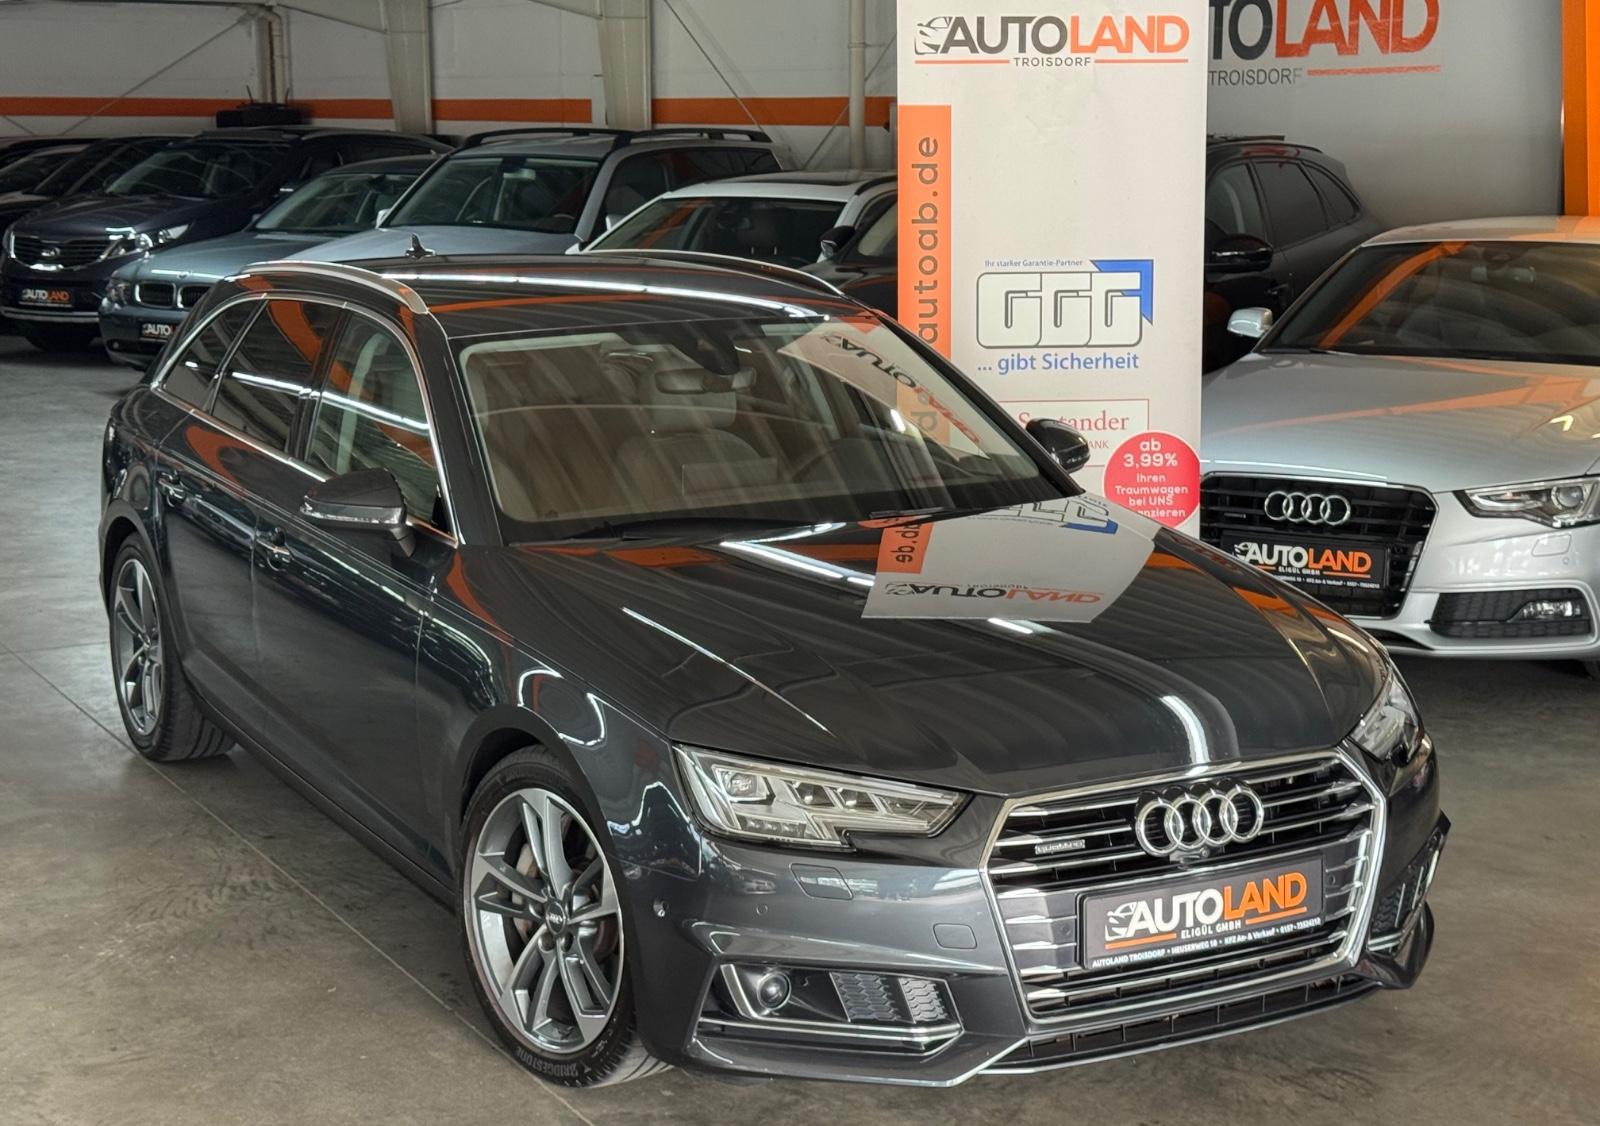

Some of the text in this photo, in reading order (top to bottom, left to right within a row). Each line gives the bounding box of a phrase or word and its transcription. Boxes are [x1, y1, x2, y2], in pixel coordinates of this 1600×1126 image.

[940, 15, 1190, 54] AUTOLAND
[1208, 0, 1440, 61] TOLAND
[1013, 56, 1092, 67] TROISDORF
[1208, 67, 1303, 86] TROISDORF
[984, 258, 1084, 268] Ihr starker Garantie-Partner
[997, 353, 1037, 376] gibt
[1041, 352, 1139, 371] Sicherheit
[1018, 410, 1129, 431] Stander
[1087, 440, 1110, 449] ANK
[1140, 438, 1162, 451] ab
[1123, 452, 1179, 469] 3,99%
[1136, 472, 1167, 483] Ihren
[1114, 484, 1189, 499] Traumwagen
[1128, 495, 1174, 506] bei UNS
[1244, 542, 1372, 575] AUTOLAND
[1123, 871, 1308, 938] AUTOLAND
[1180, 919, 1242, 940] ELIGÜL GMBH
[1092, 952, 1129, 968] AUTOLAND
[1129, 948, 1165, 963] TROISDORF
